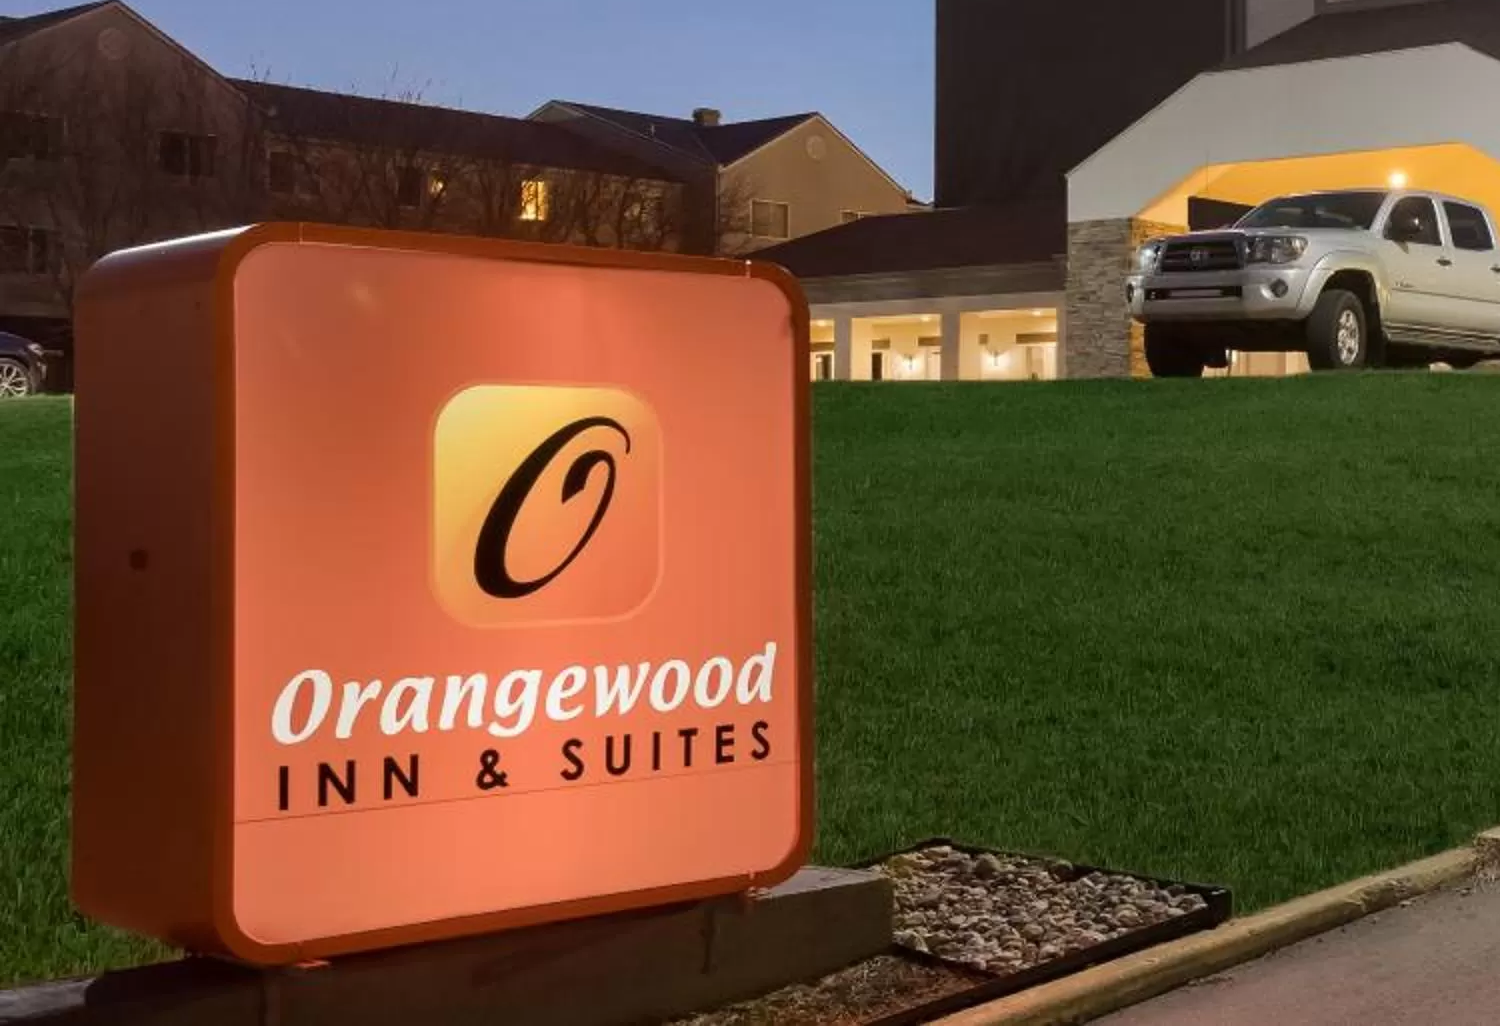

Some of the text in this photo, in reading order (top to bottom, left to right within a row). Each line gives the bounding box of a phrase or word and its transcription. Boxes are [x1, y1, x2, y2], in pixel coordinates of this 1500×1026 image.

[271, 641, 778, 745] Orangewood
[278, 720, 772, 811] INN & SUITES
